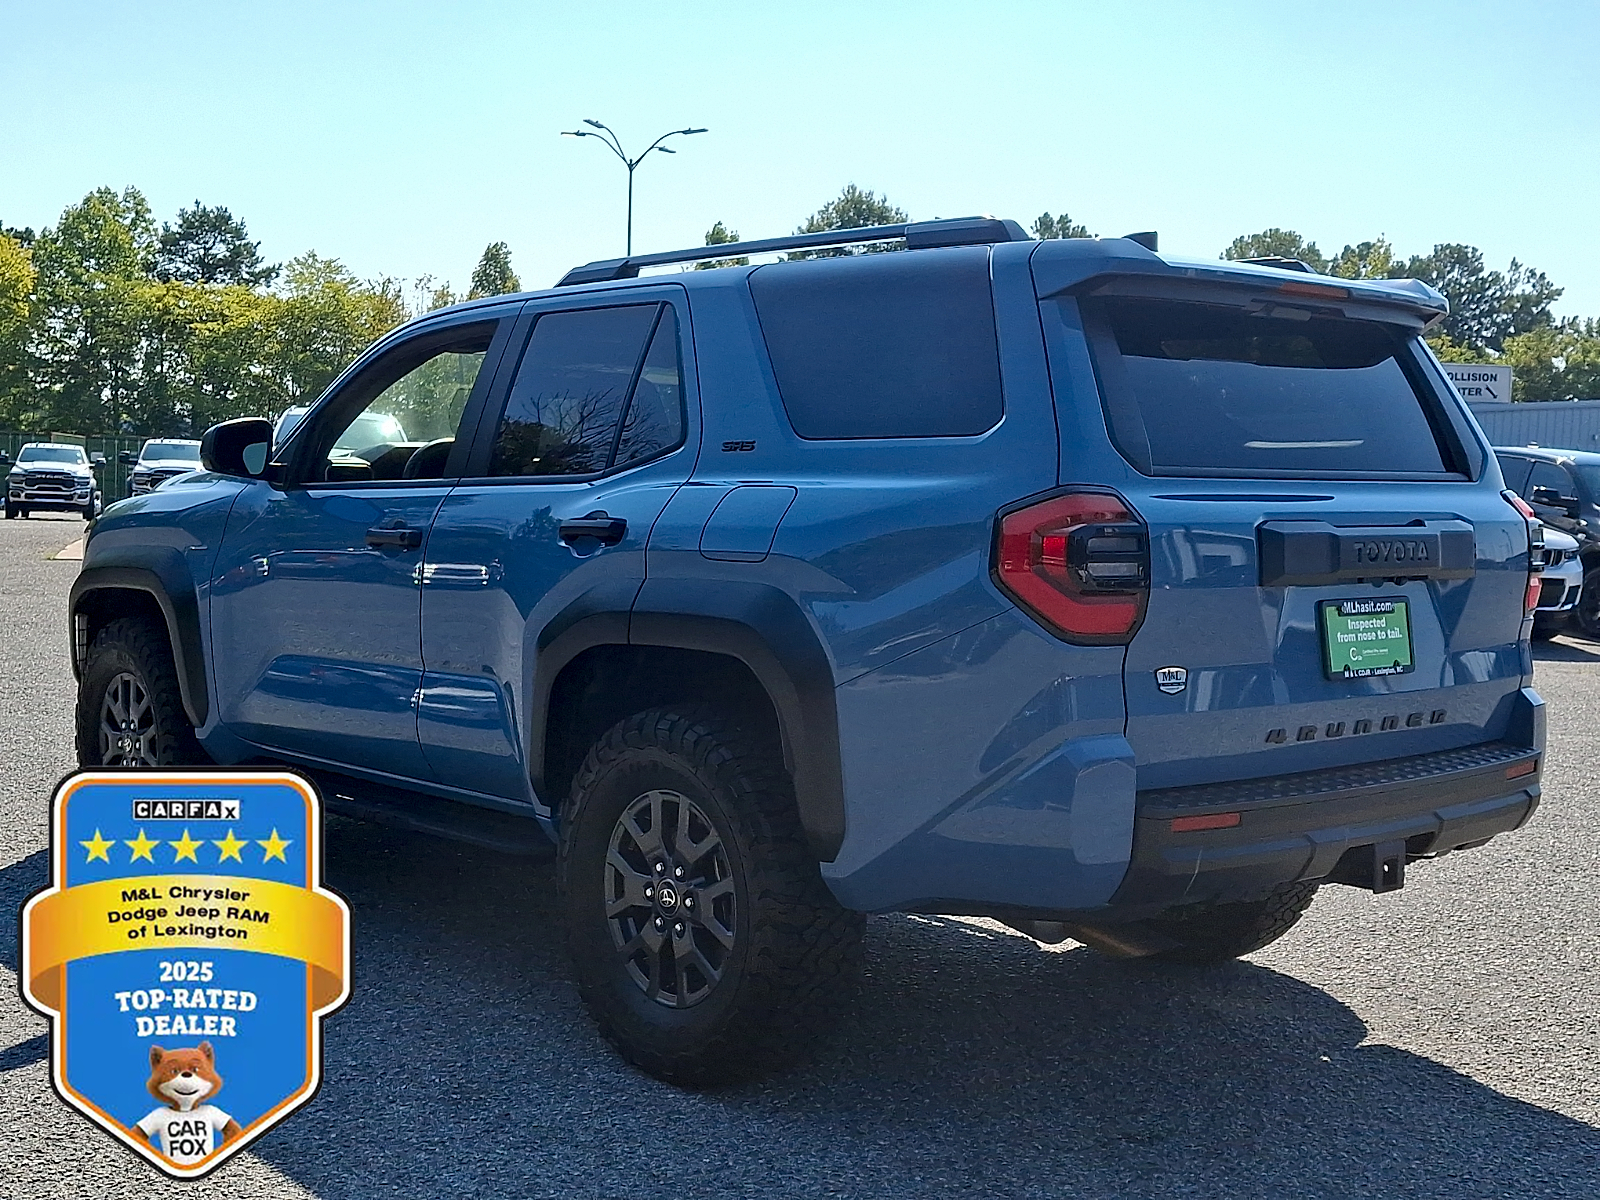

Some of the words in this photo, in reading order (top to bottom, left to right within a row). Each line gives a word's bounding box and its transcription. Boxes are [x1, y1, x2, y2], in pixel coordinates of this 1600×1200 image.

[1447, 372, 1498, 382] OLLISION
[1355, 541, 1429, 563] TOYOTA
[1348, 617, 1386, 630] Inspected
[1337, 632, 1357, 643] from
[1358, 631, 1376, 640] nose
[1377, 629, 1386, 639] to
[1387, 627, 1403, 638] tail.
[1162, 670, 1182, 682] M&L
